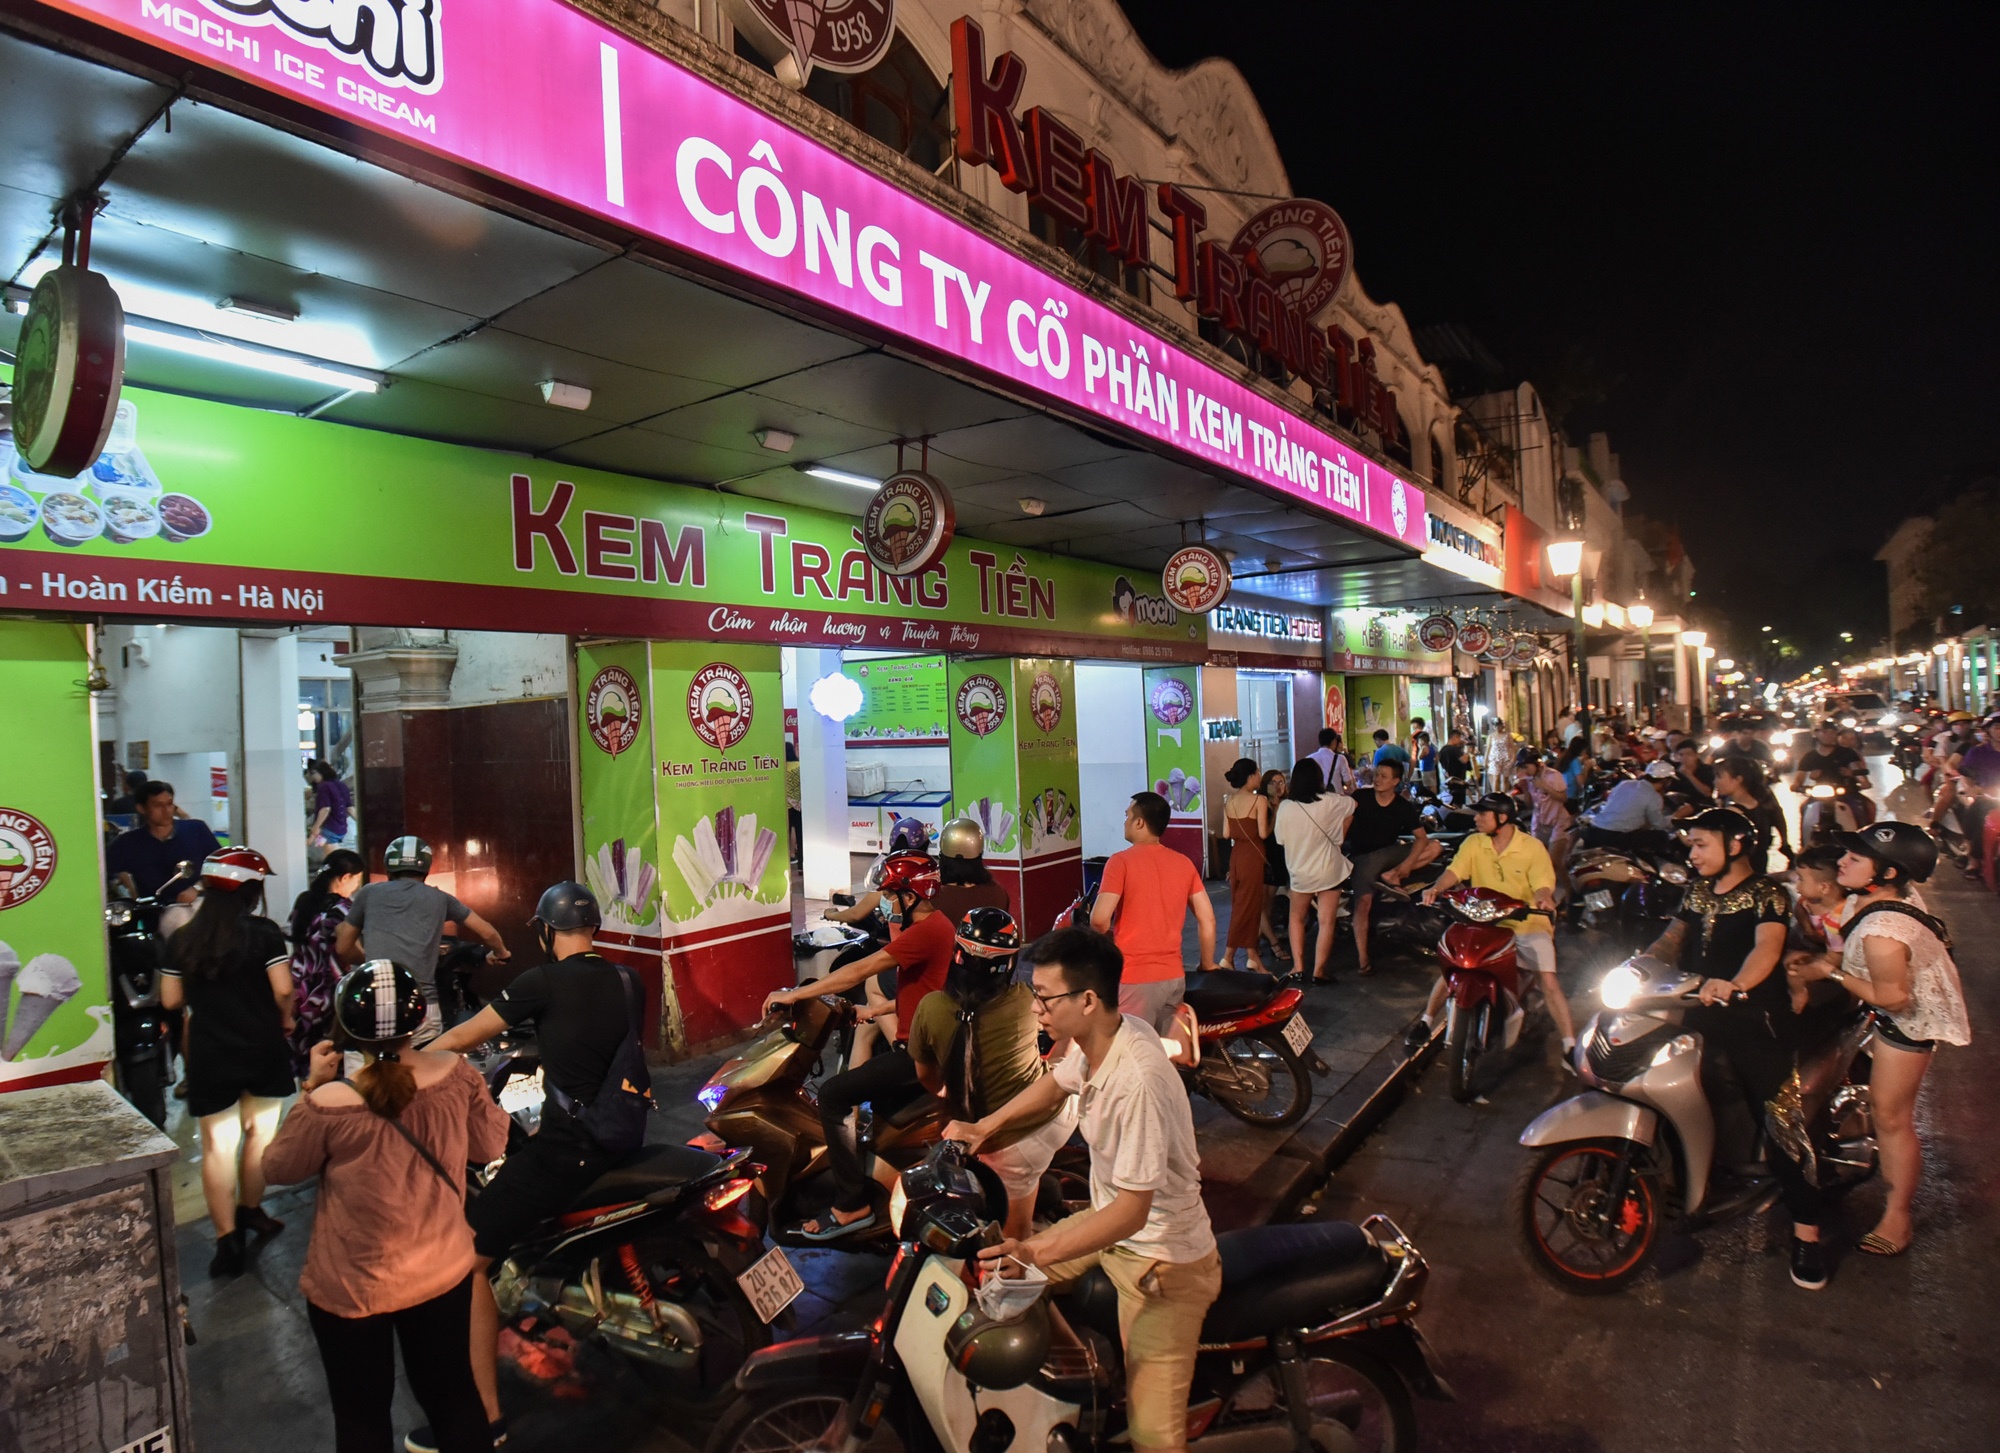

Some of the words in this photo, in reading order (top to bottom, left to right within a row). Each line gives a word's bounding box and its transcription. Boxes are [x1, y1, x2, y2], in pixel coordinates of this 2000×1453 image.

[827, 11, 873, 52] 1958
[141, 0, 259, 63] MOCHI
[274, 49, 325, 89] ICE
[337, 76, 436, 134] CREAM
[951, 14, 1150, 267] KEM
[1303, 278, 1333, 313] 1958
[675, 137, 902, 307] CÔNG
[919, 249, 991, 345] TY
[1006, 297, 1070, 380] CỔ
[1082, 333, 1179, 431] PHẦN
[1187, 387, 1243, 459] KEM
[1248, 419, 1319, 493] TRÀNG
[1321, 454, 1361, 512] TIỀN
[869, 506, 880, 538] KEM
[873, 542, 890, 558] Since
[906, 535, 923, 556] 1958
[42, 572, 128, 601] Hoàn
[137, 575, 213, 606] Kiếm
[239, 585, 274, 609] Hà
[282, 587, 324, 616] Nội
[969, 550, 1056, 621] TIỀN
[1168, 567, 1176, 589] KEM
[708, 607, 755, 633] Cảm
[770, 612, 808, 634] nhận
[823, 615, 867, 643] hương
[880, 627, 891, 640] vị
[588, 691, 598, 725] KEM
[594, 669, 629, 687] TRÀNG
[689, 685, 702, 719] KEM
[698, 665, 740, 685] TRÀNG
[958, 691, 966, 715] KEM
[594, 729, 609, 748] Since
[620, 726, 635, 747] 1958
[697, 724, 715, 742] Since
[730, 722, 745, 741] 1958
[987, 715, 1000, 729] 1958
[662, 760, 693, 777] KEM
[700, 757, 747, 774] TRÀNG
[10, 875, 41, 900] 1958
[1199, 1020, 1236, 1034] Wave
